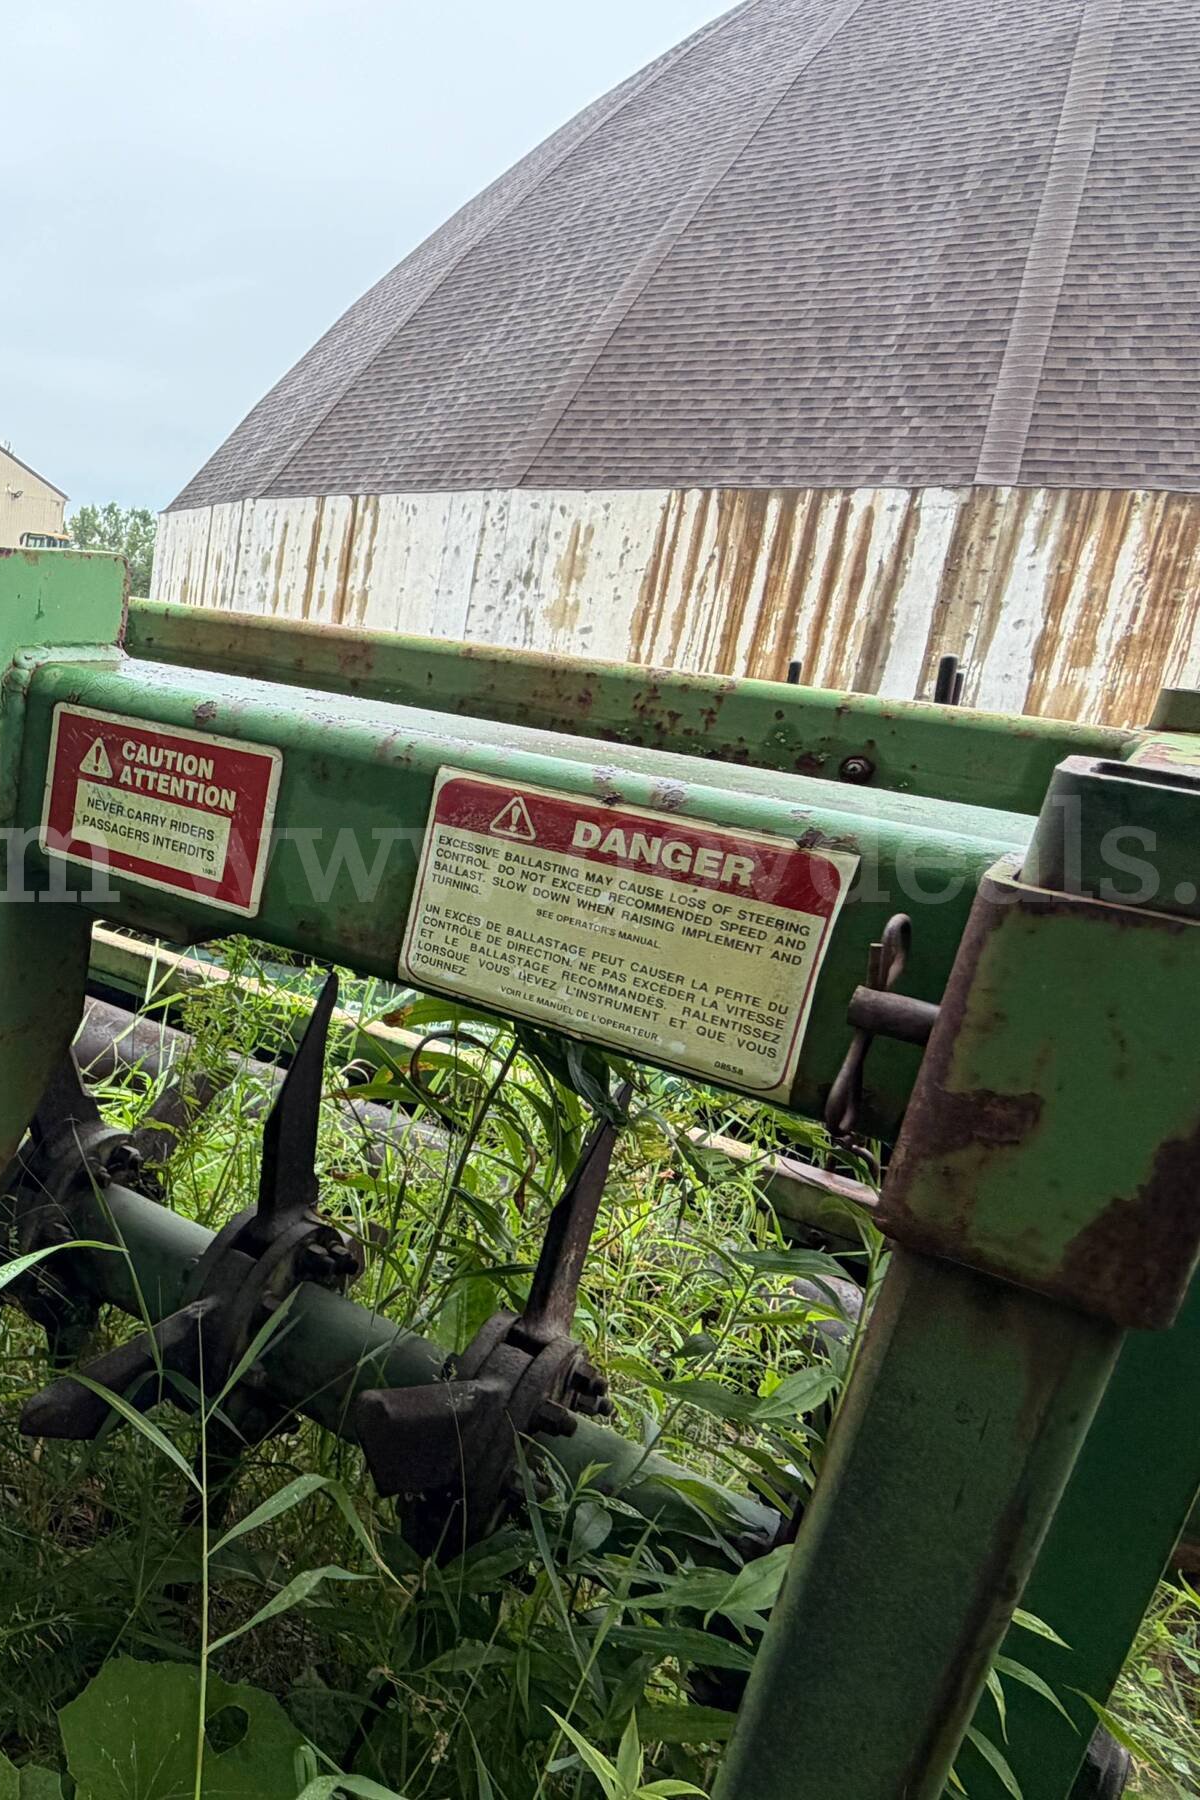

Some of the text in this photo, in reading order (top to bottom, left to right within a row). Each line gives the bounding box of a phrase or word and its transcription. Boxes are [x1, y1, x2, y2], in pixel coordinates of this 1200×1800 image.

[118, 764, 237, 811] ATTENTION
[121, 739, 214, 780] CAUTION
[82, 814, 215, 862] PASSAGERS INTERDITS
[86, 796, 215, 842] NEVER CARRY RIDERS
[430, 873, 483, 895] TURNING.
[438, 835, 811, 936] EXCESSIVE BALLASTING MAY CAUSE LOSS OF STEERING
[572, 820, 756, 887] DANGER
[433, 860, 802, 966] BALLAST. SLOW DOWN WHEN RAISING IMPLEMENT AND
[497, 863, 515, 876] DO
[520, 869, 546, 884] NOT
[551, 877, 601, 898] EXCEED
[607, 891, 713, 927] RECOMMENDED
[719, 920, 768, 941] SPEED
[774, 934, 807, 951] AND
[535, 908, 553, 919] SEE
[419, 928, 433, 939] ET
[444, 935, 459, 947] LE
[469, 942, 550, 974] BALLASTAGE
[681, 1006, 781, 1044] RALENTISSEZ
[425, 903, 440, 915] UN
[485, 920, 501, 933] DE
[505, 926, 586, 957] BALLASTAGE
[591, 950, 624, 968] PEUT
[629, 961, 685, 985] CAUSER
[690, 978, 709, 992] LA
[714, 985, 762, 1007] PERTE
[767, 1001, 789, 1015] DU
[486, 933, 502, 946] DE
[578, 960, 596, 974] NE
[601, 967, 627, 983] PAS
[700, 996, 719, 1010] LA
[724, 1003, 786, 1030] VITESSE
[416, 940, 777, 1058] LORSQUE VOUS LEVEZ L'INSTRUMENT ET QUE VOUS
[499, 985, 521, 998] VOIR
[523, 992, 534, 1002] LE
[535, 997, 574, 1015] MANUEL
[576, 1009, 589, 1019] DE
